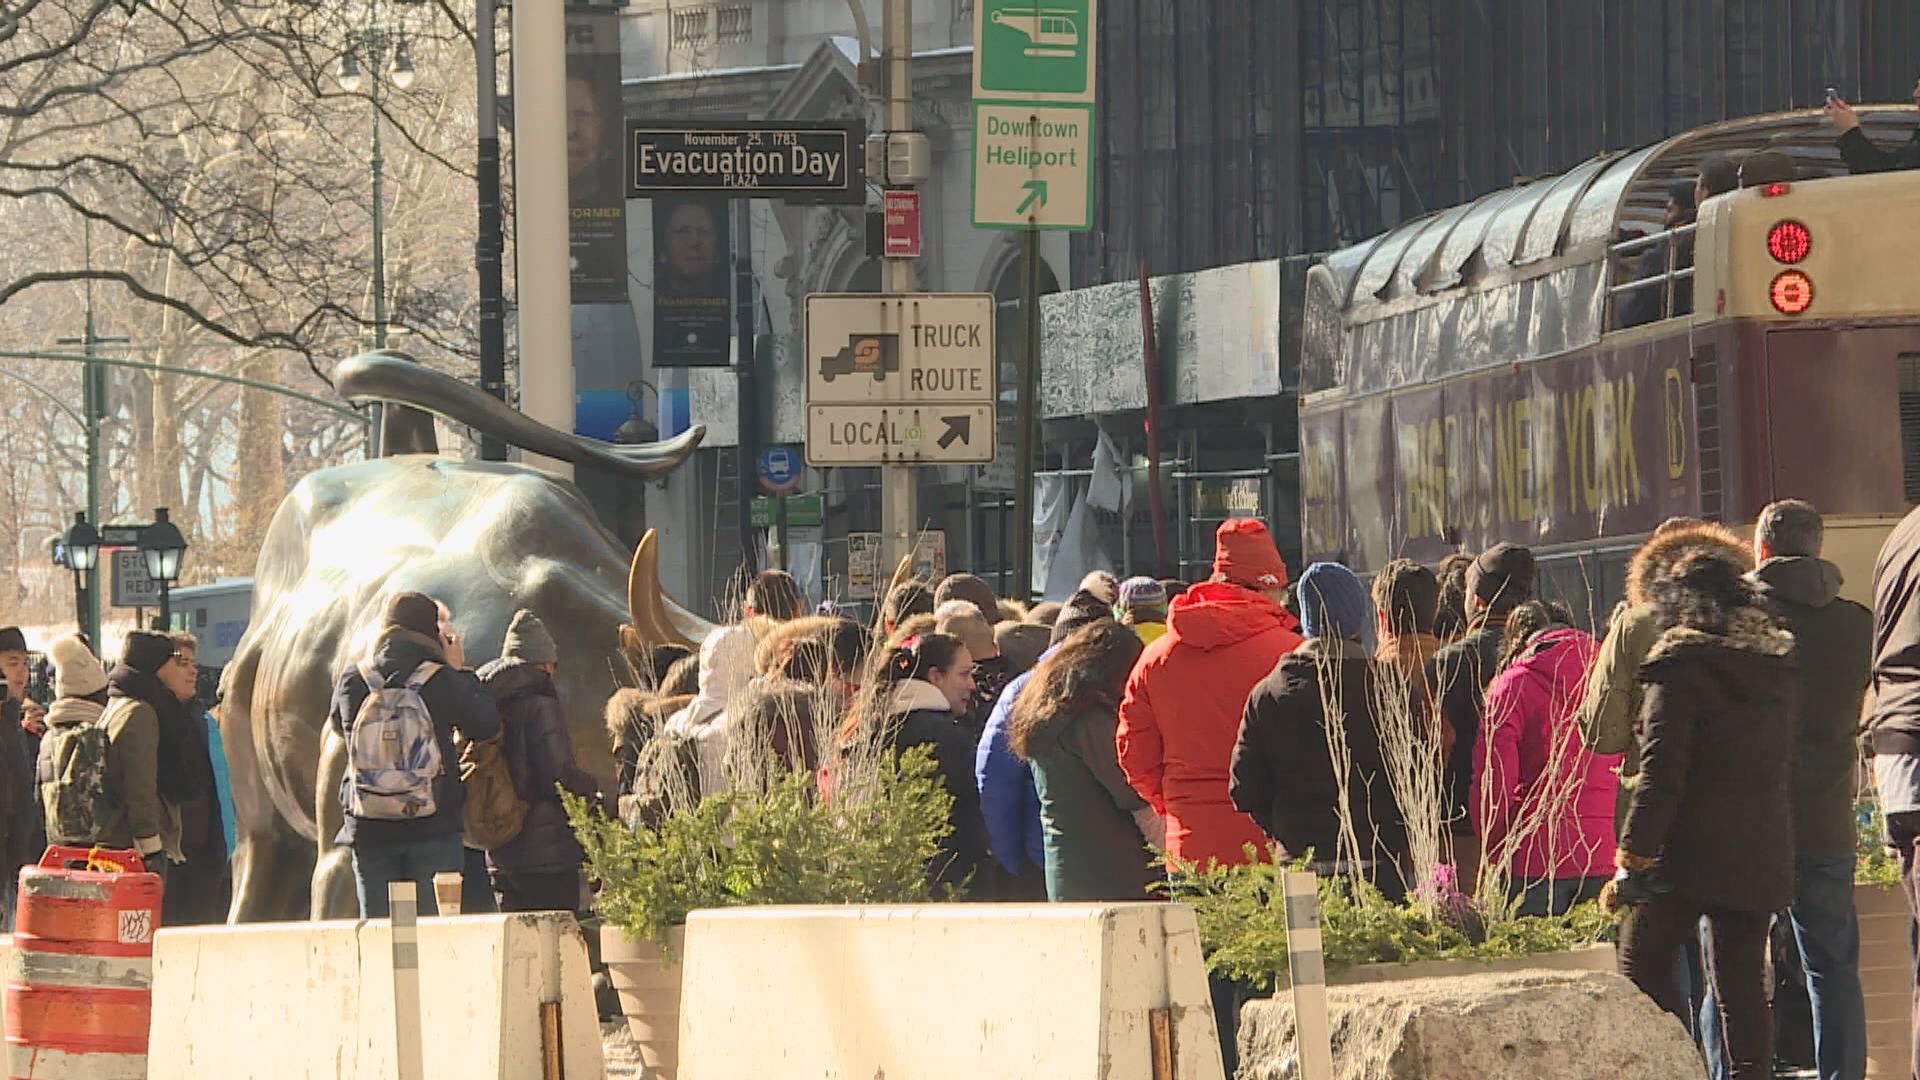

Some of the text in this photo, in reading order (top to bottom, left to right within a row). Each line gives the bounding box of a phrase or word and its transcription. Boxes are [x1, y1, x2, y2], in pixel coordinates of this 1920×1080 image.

[987, 115, 1078, 138] Downtown
[684, 133, 738, 146] November
[772, 133, 797, 146] 1783
[640, 144, 840, 181] Evacuation Day
[986, 144, 1077, 169] Heliport
[723, 174, 759, 186] PLAZA
[910, 324, 982, 348] TRUCK
[911, 368, 982, 391] ROUTE
[830, 422, 903, 445] LOCAL
[1562, 369, 1641, 515] YORK
[121, 555, 148, 569] STO
[125, 580, 154, 593] RED
